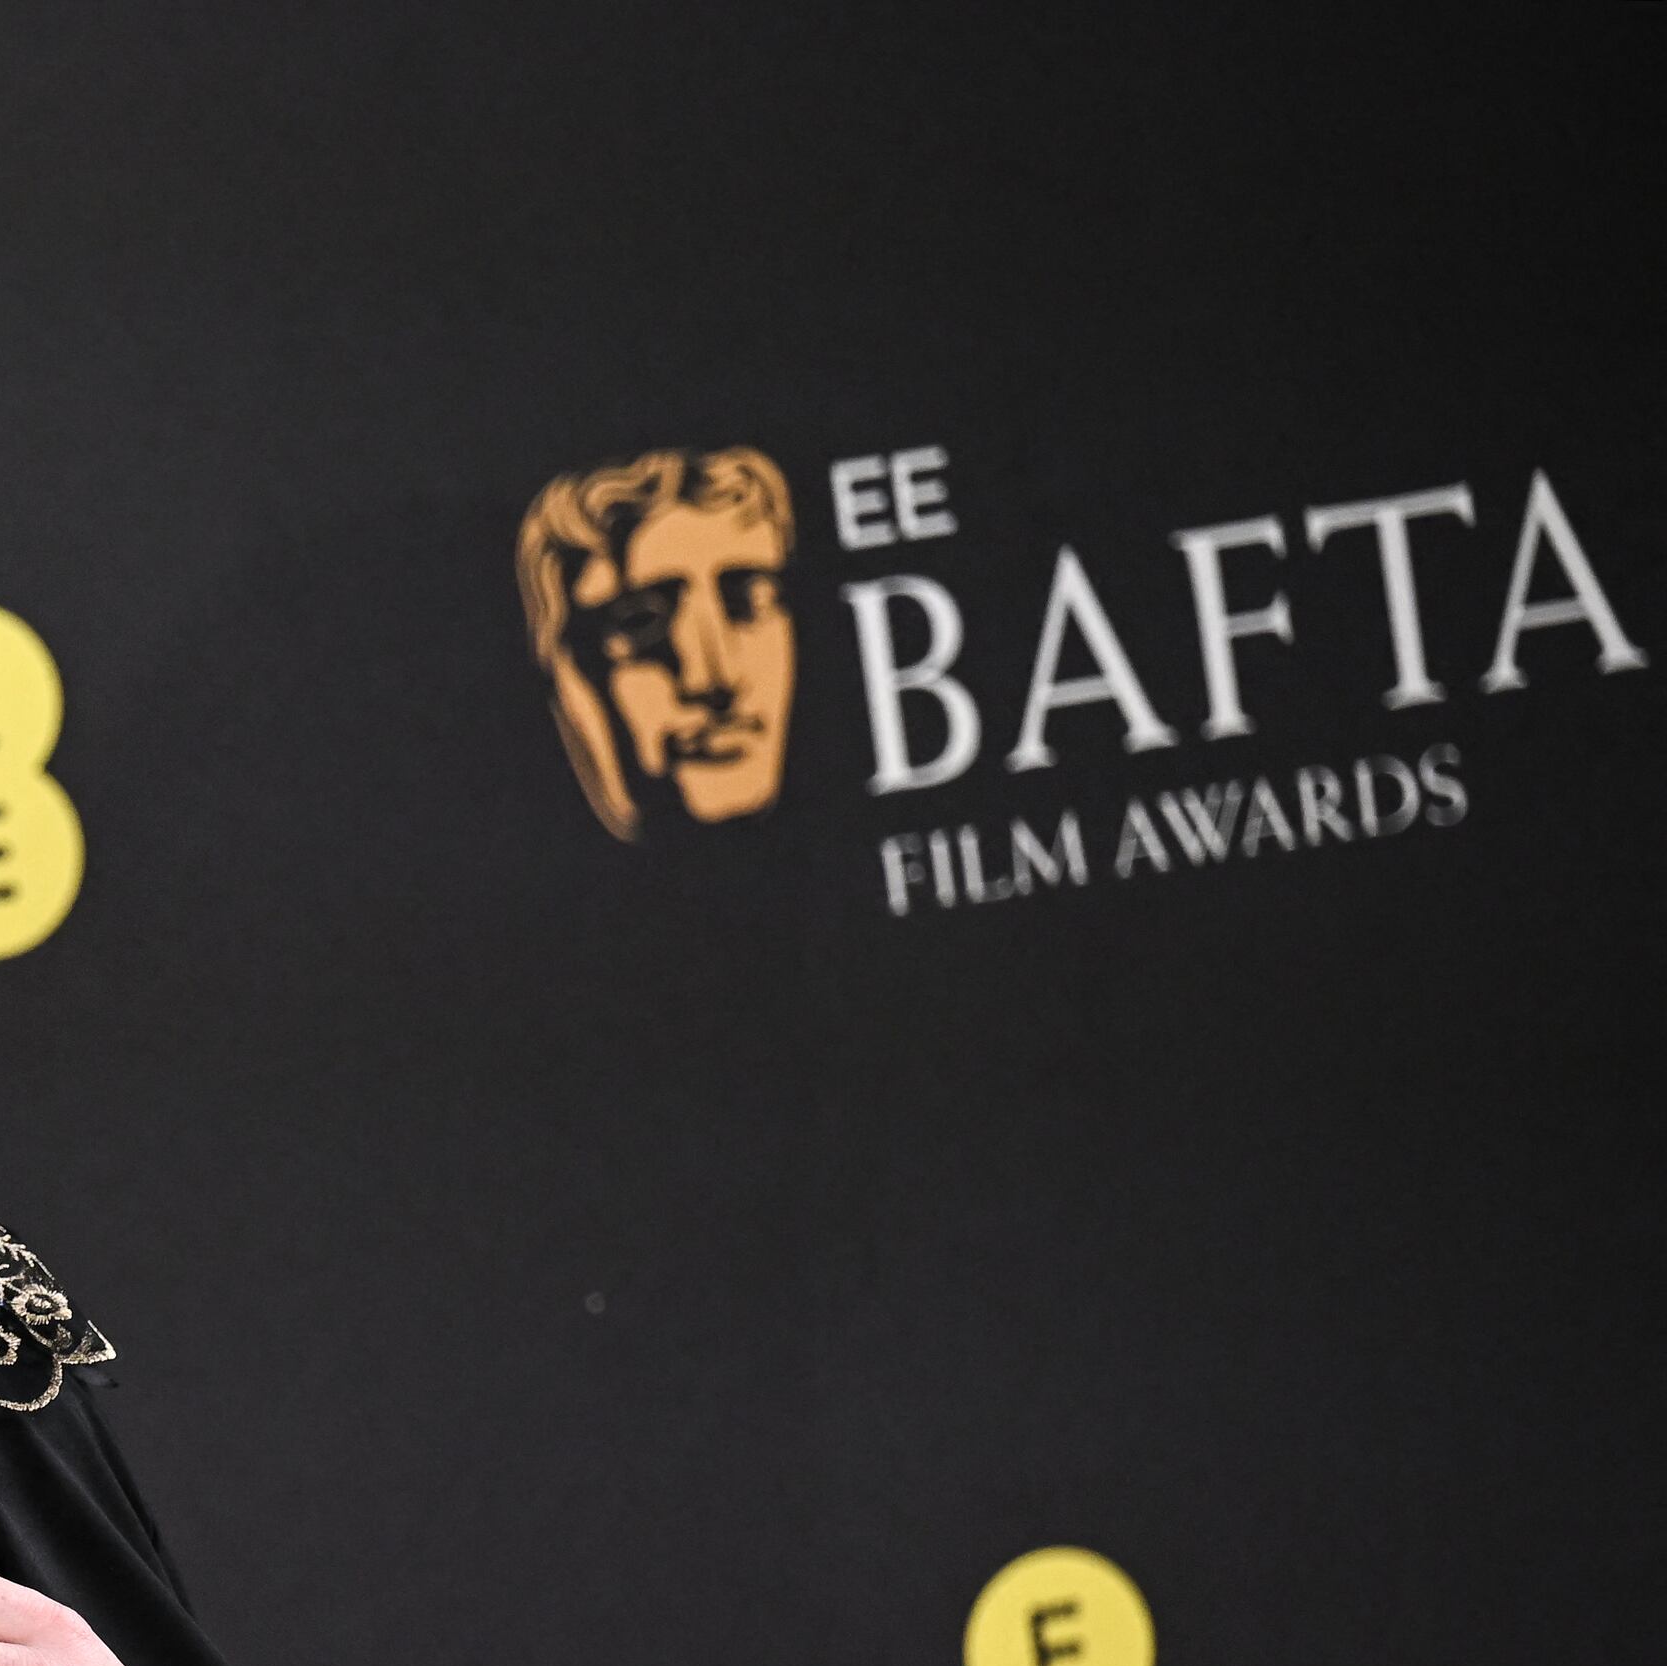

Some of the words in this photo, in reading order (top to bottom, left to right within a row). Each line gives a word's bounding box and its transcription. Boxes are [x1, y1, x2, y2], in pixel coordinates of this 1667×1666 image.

[830, 447, 956, 550] EE
[841, 471, 1647, 796] BAFTA
[880, 812, 1088, 916] FILM
[1115, 753, 1467, 878] AWARDS
